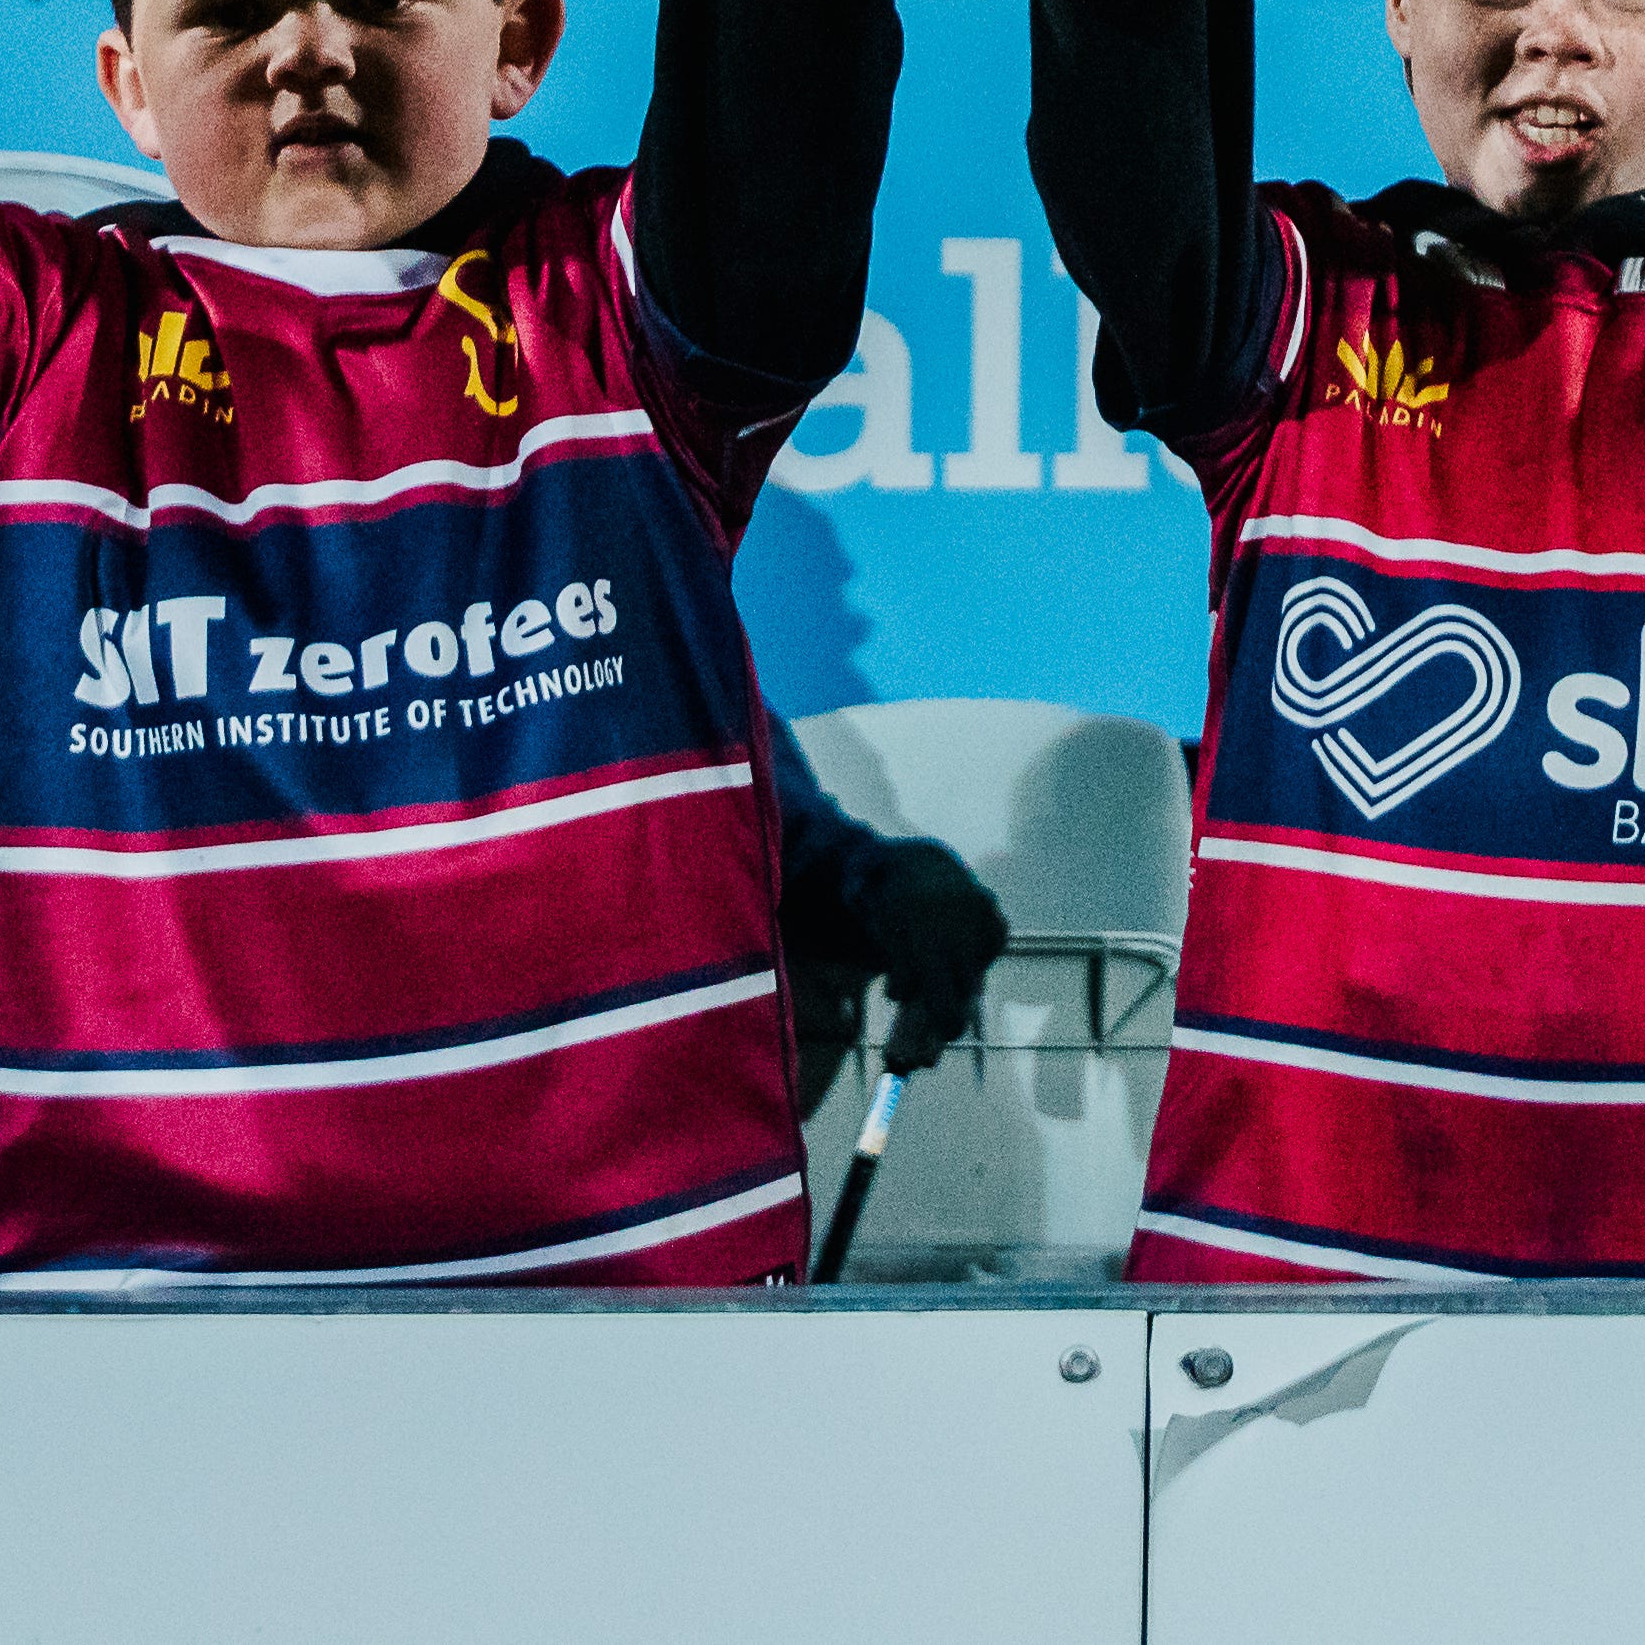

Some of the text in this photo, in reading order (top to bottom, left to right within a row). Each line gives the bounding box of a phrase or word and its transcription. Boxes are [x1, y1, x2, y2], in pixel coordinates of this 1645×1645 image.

[74, 578, 618, 710] SIT zerofees
[68, 655, 625, 759] SOUTHERN INSTITUTE OF TECHNOLOGY
